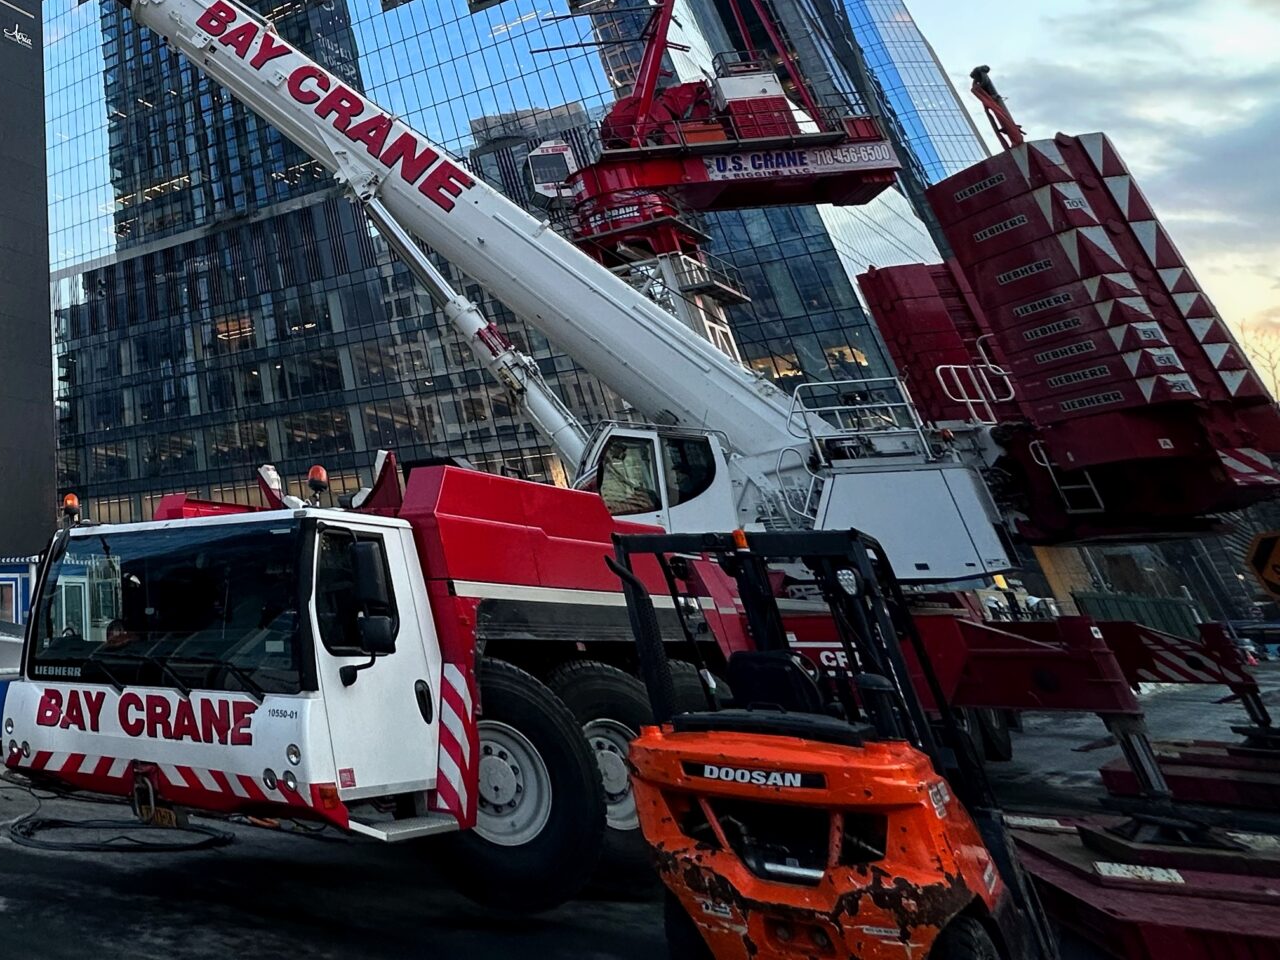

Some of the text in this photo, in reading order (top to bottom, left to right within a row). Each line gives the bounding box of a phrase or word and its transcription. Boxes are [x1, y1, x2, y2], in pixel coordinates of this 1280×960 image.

[196, 0, 477, 213] BAY CRANE
[716, 144, 891, 173] U.S. CRANE 718-456-6500
[955, 173, 1005, 201] LIEBHERR
[974, 216, 1027, 242] LIEBHERR
[997, 259, 1053, 285] LIEBHERR
[1014, 293, 1072, 317] LIEBHERR
[1023, 317, 1082, 341] LIEBHERR
[1036, 342, 1095, 364] LIEBHERR
[1048, 366, 1110, 388] LIEBHERR
[1061, 391, 1123, 412] LIEBHERR
[34, 665, 81, 677] LIEBHERR
[36, 688, 298, 746] BAY CRANE 10550-01
[703, 764, 802, 788] DOOSAN
